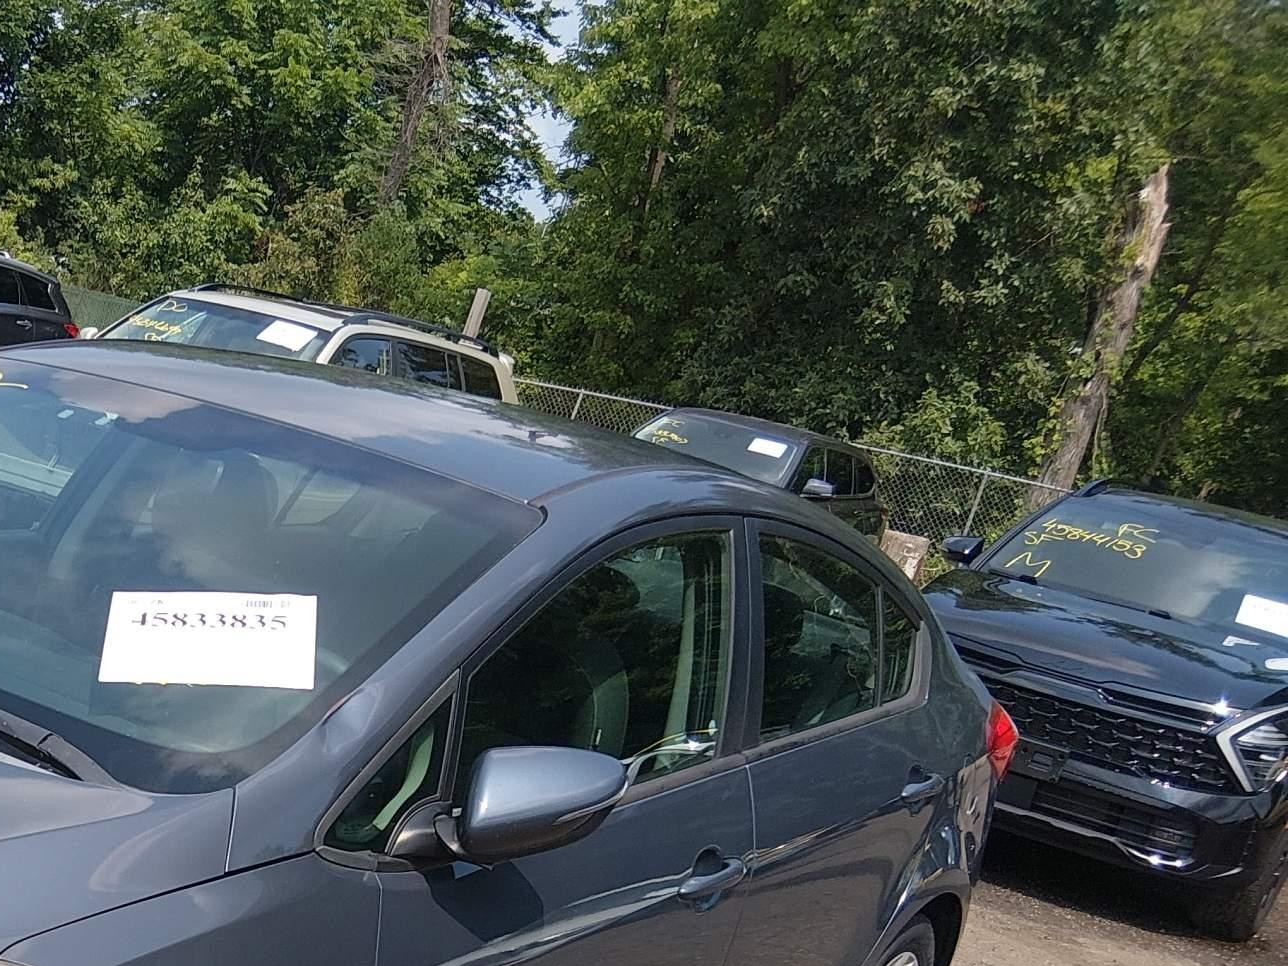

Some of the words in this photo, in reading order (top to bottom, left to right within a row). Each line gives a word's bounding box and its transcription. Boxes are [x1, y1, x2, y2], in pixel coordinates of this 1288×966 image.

[1042, 518, 1147, 559] 45844153
[1004, 552, 1052, 577] M
[131, 611, 289, 631] 45833835
